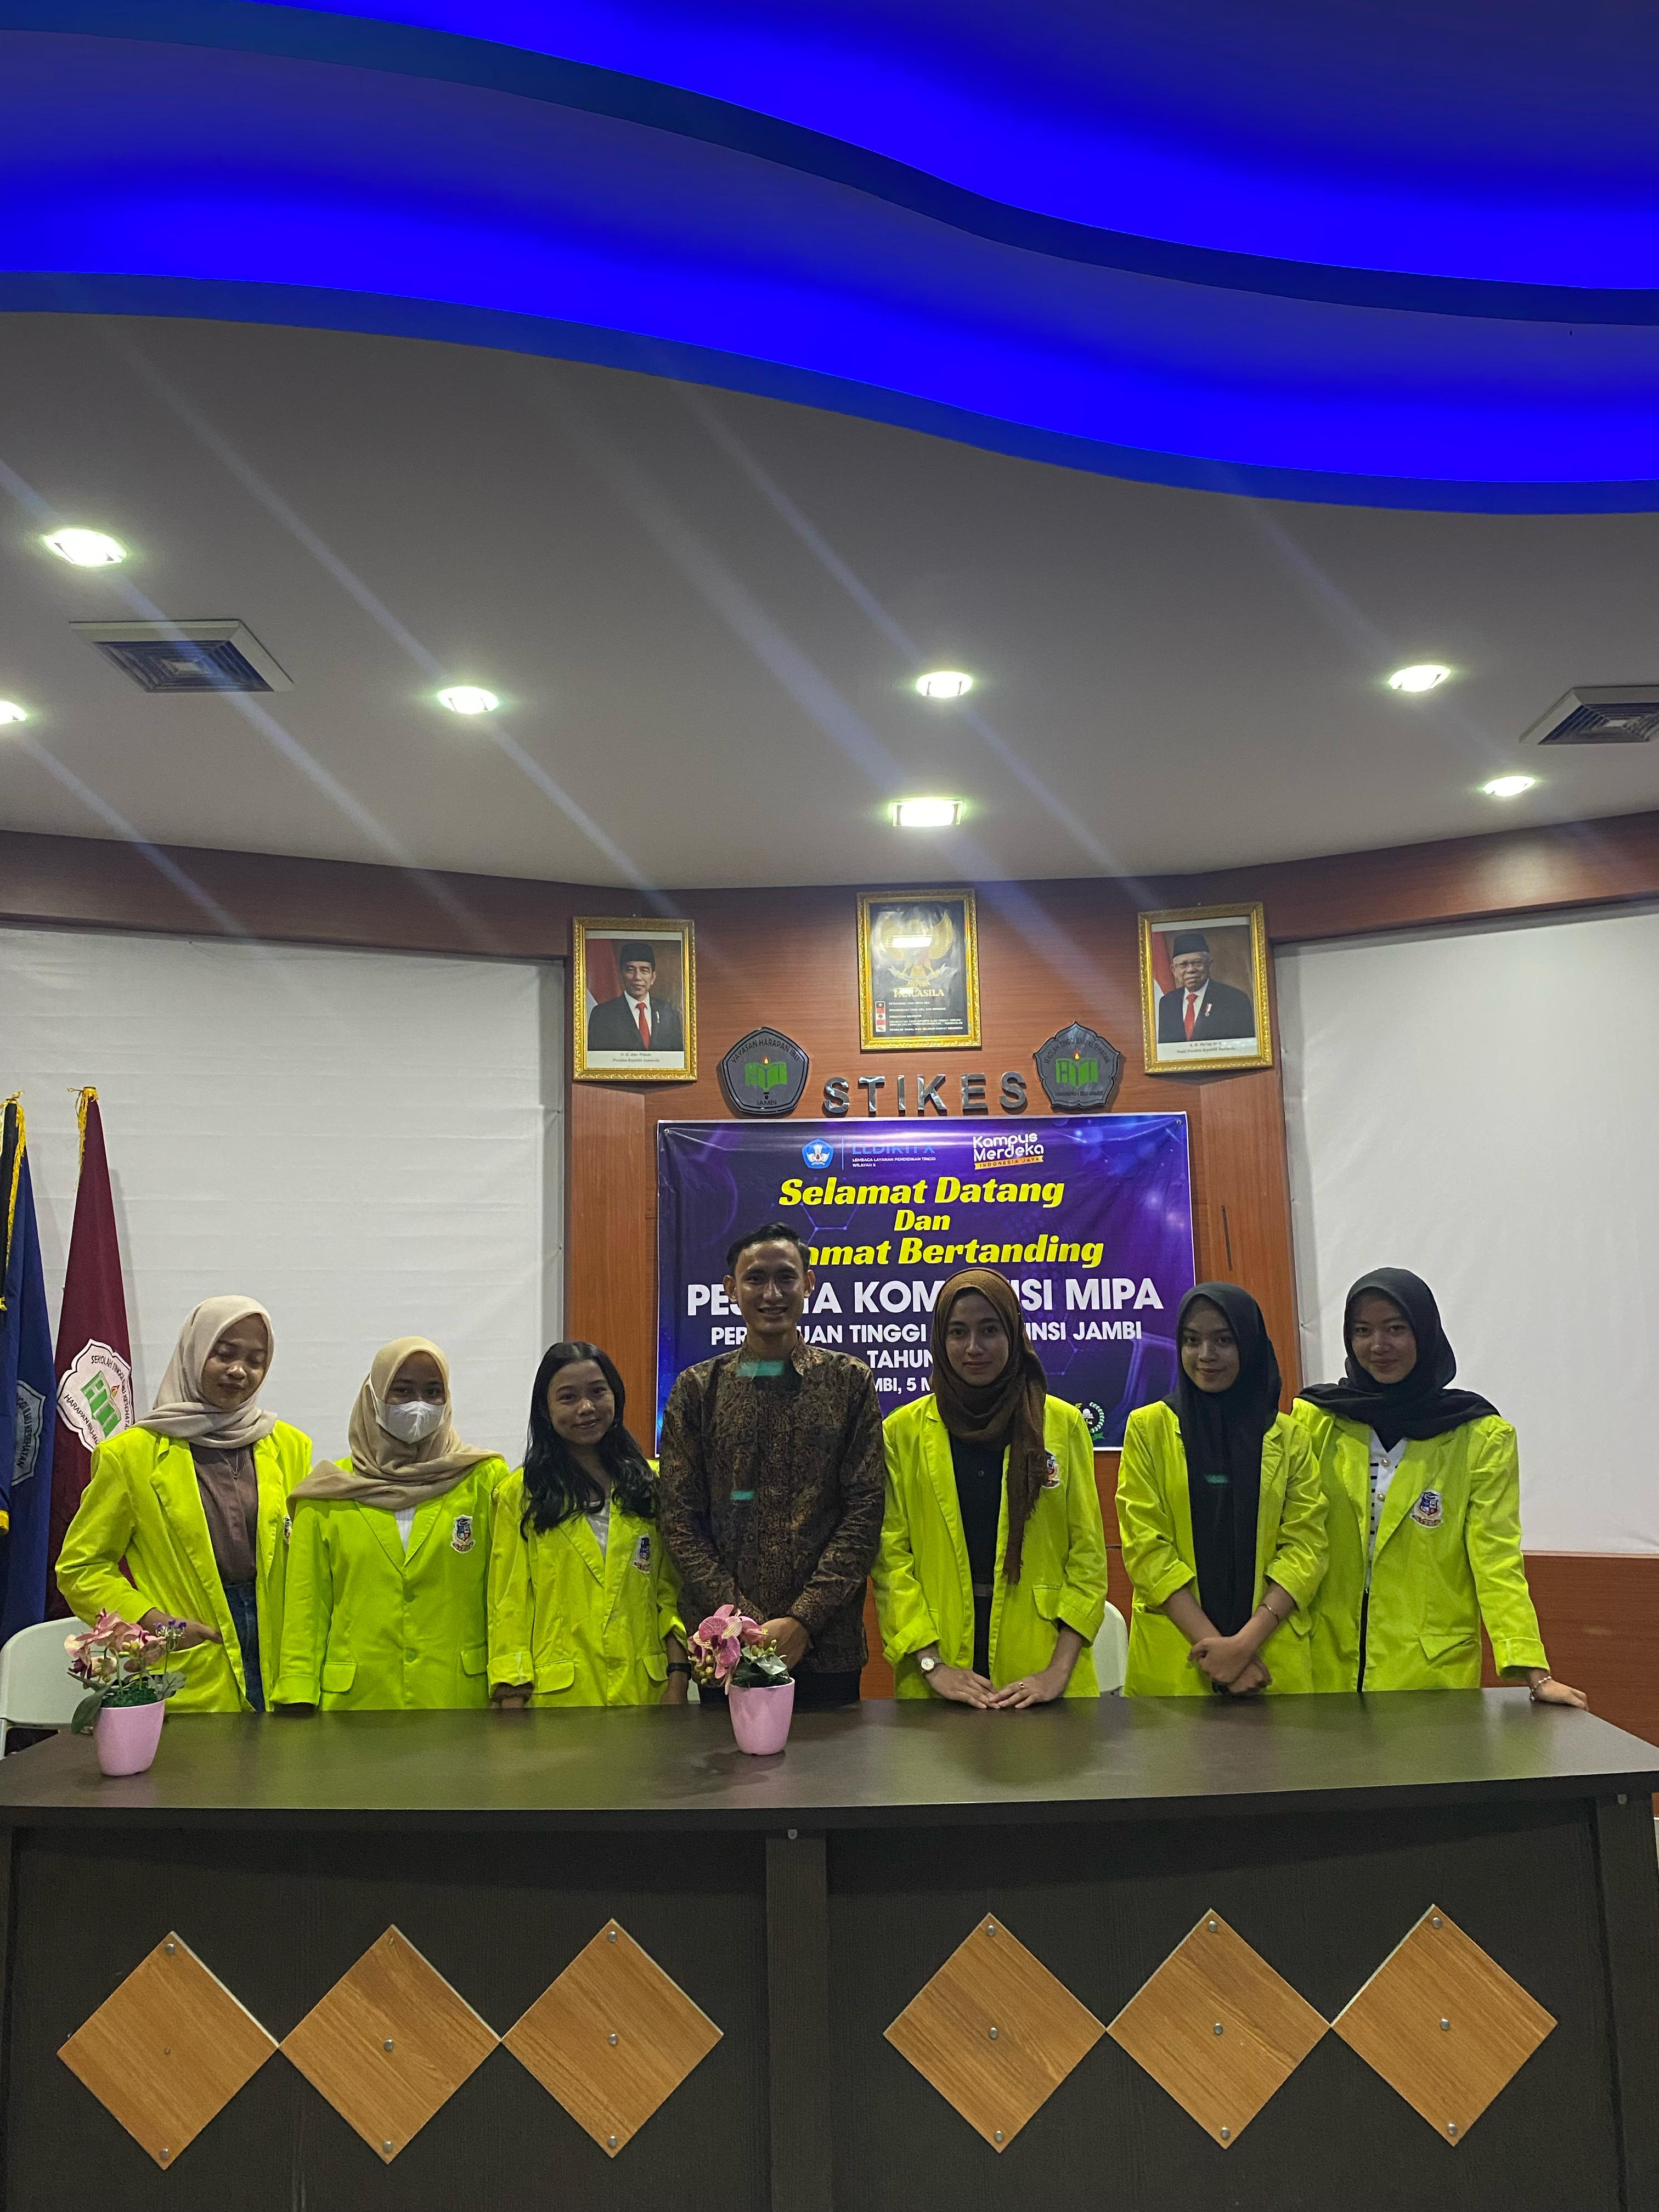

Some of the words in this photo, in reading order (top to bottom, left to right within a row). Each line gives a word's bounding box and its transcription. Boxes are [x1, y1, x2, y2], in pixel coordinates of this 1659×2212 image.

[732, 1041, 757, 1062] YAYASAN
[759, 1039, 790, 1053] HARAPAN
[790, 1051, 800, 1061] IBU
[823, 1071, 1028, 1114] STIKES
[973, 1132, 1038, 1149] Kampus
[974, 1142, 1044, 1162] Merdeka
[979, 1159, 1019, 1168] INDONESIA
[778, 1177, 928, 1206] Selamat
[934, 1176, 1065, 1207] Datang
[894, 1209, 951, 1232] Dan
[808, 1240, 891, 1265] amat
[898, 1234, 1104, 1268] Bertanding
[1065, 1278, 1164, 1310] MIPA
[849, 1324, 927, 1343] TINGGI
[1073, 1321, 1142, 1340] JAMBI
[91, 1355, 113, 1370] SEKOLAH
[867, 1349, 933, 1368] TAHUN
[906, 1377, 917, 1392] 5
[64, 1394, 89, 1424] HARAPAN
